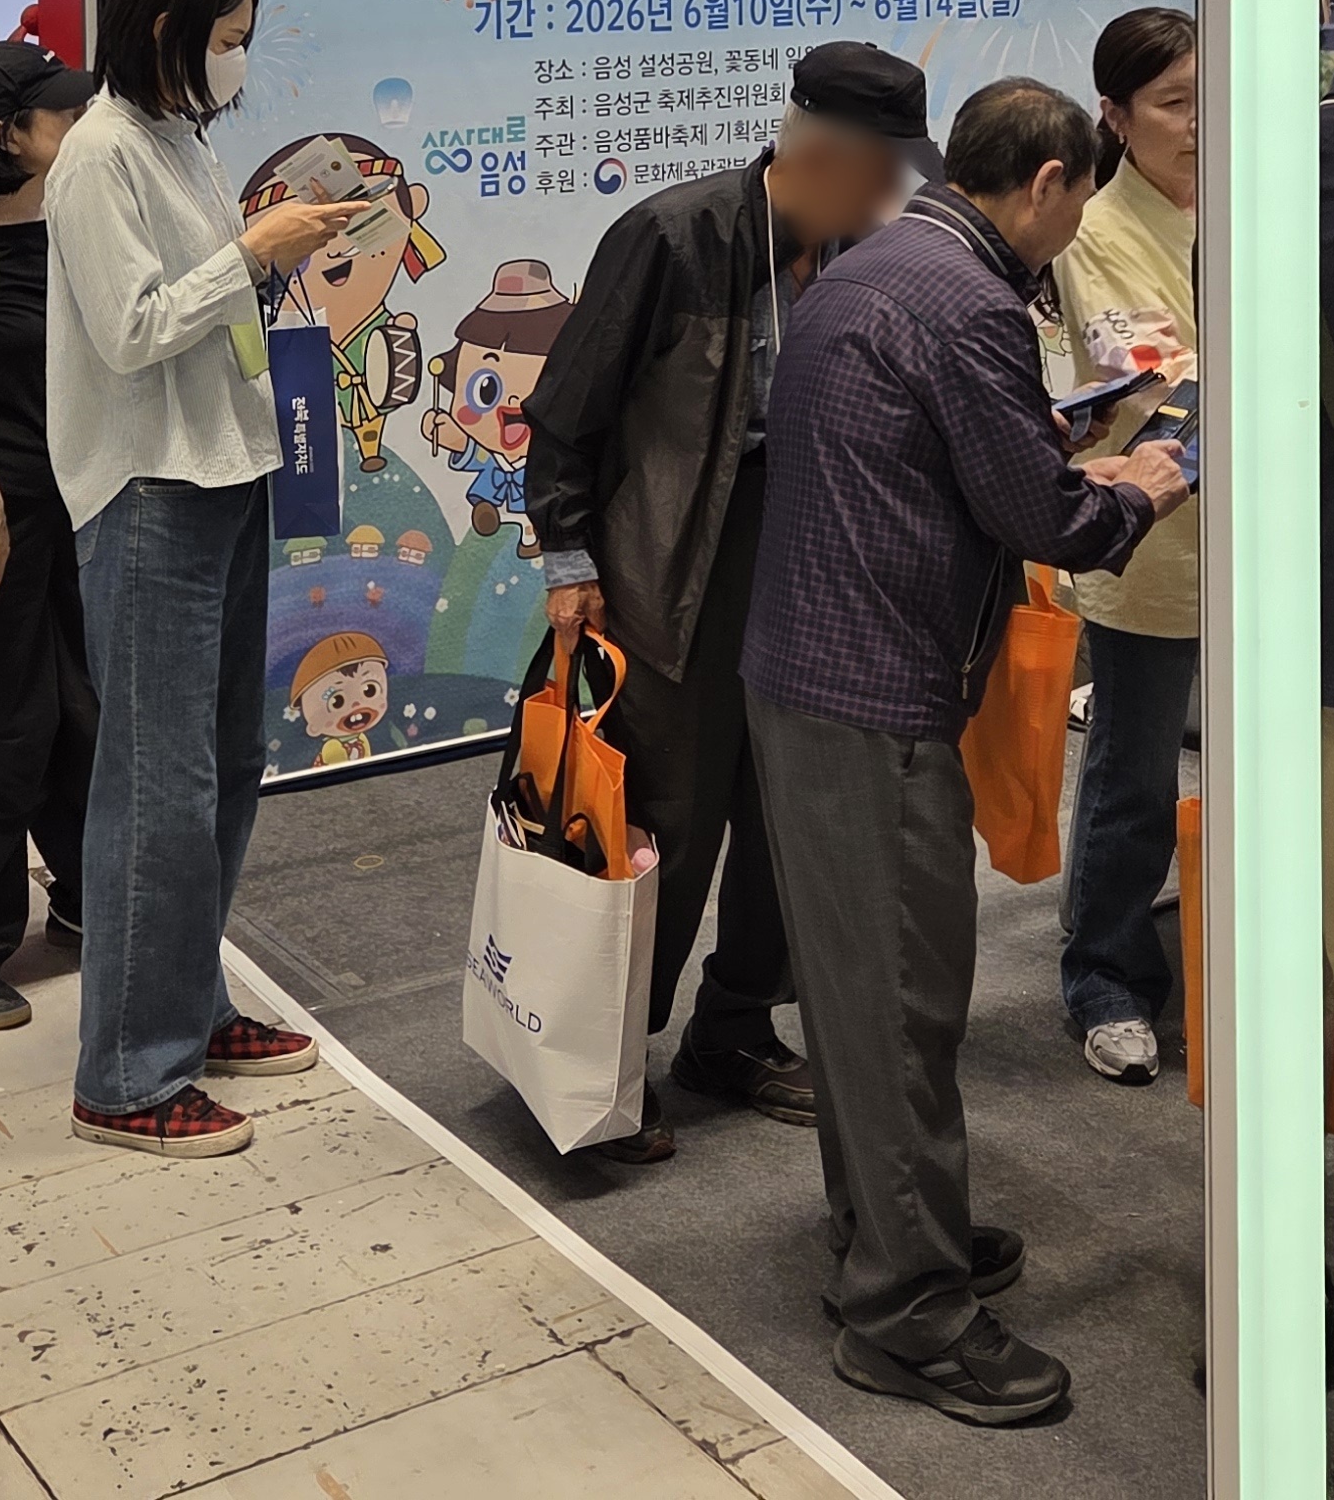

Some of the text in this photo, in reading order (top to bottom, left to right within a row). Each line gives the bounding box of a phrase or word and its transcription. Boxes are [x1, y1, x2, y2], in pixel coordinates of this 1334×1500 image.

[533, 57, 575, 85] 장소
[592, 55, 632, 81] 음성
[637, 49, 720, 79] 설성공원,
[724, 48, 779, 75] 꽃동네
[533, 96, 575, 121] 주최
[593, 91, 653, 118] 음성군
[657, 81, 787, 113] 축제추진위원회
[534, 132, 576, 159] 주관
[593, 123, 709, 155] 음성품바축제
[479, 149, 527, 198] 음성
[534, 168, 575, 195] 후원
[466, 951, 543, 1034] SEAWORLD
